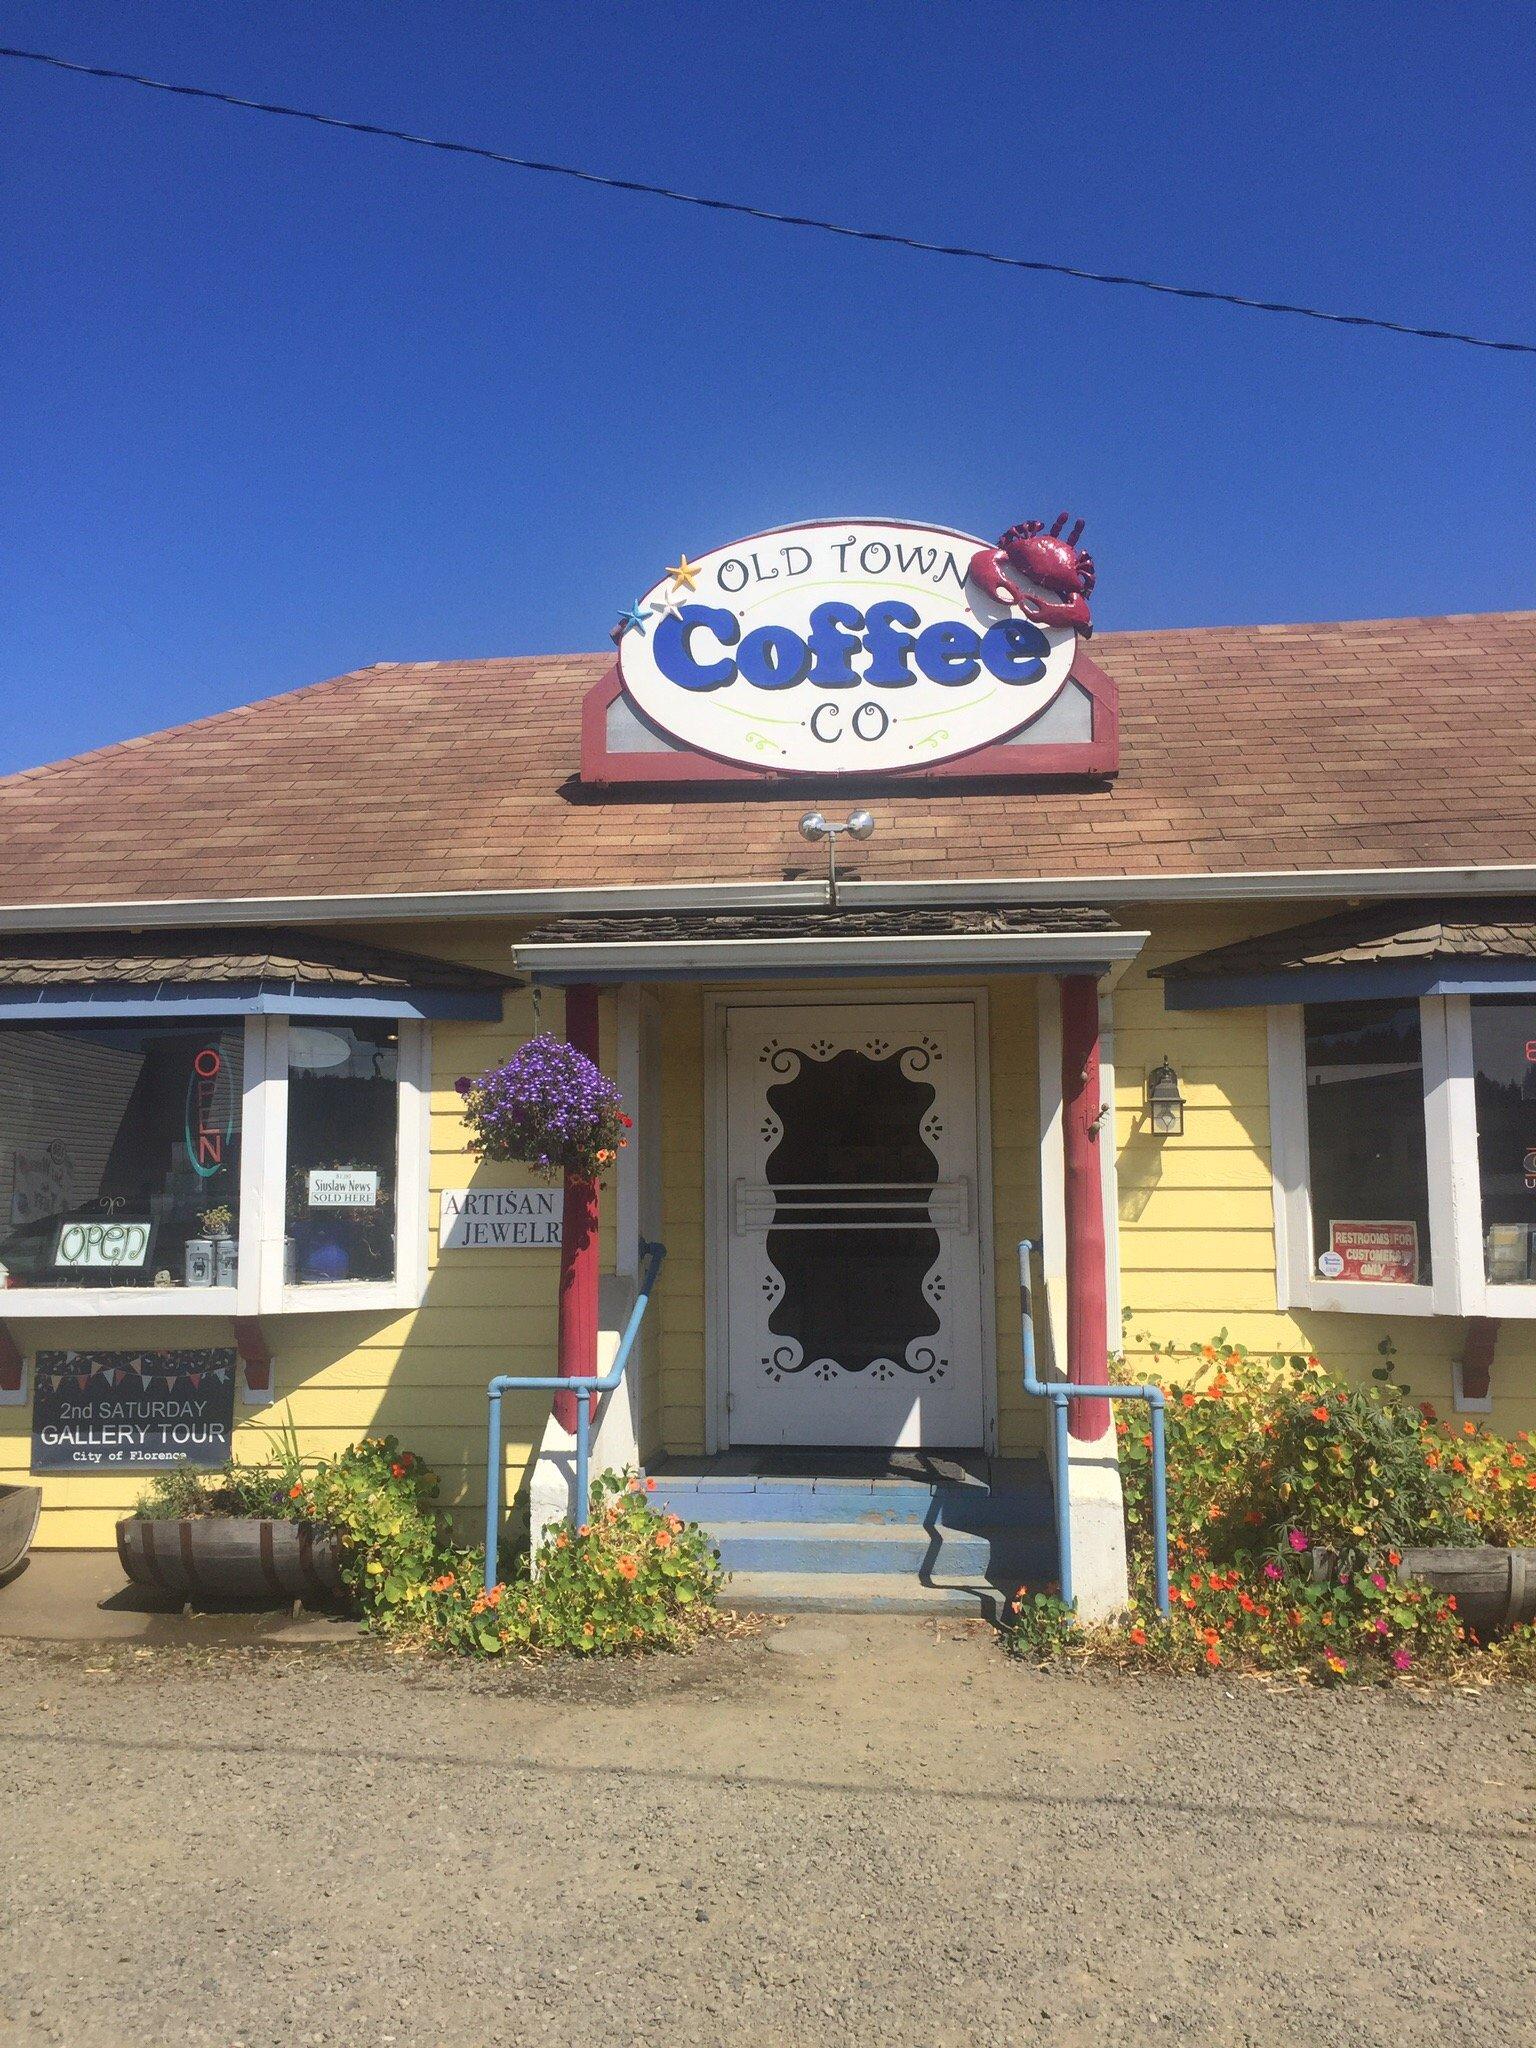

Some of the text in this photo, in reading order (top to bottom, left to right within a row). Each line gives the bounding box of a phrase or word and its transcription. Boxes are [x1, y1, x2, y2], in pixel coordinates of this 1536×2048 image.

[717, 535, 972, 592] OLD TOWN
[652, 600, 1052, 693] Coffee
[810, 701, 889, 743] CO
[315, 1179, 371, 1191] Siuslaw News
[313, 1194, 373, 1202] SOLD HERE
[444, 1192, 554, 1215] ARTISAN
[462, 1220, 563, 1246] JEWELR
[1335, 1232, 1412, 1245] RESTROOMS FOR
[1361, 1263, 1386, 1276] ONLY
[60, 1401, 208, 1419] 2nd SATURDAY
[40, 1422, 226, 1445] GALLERY TOUR
[72, 1451, 187, 1463] City of Florence
